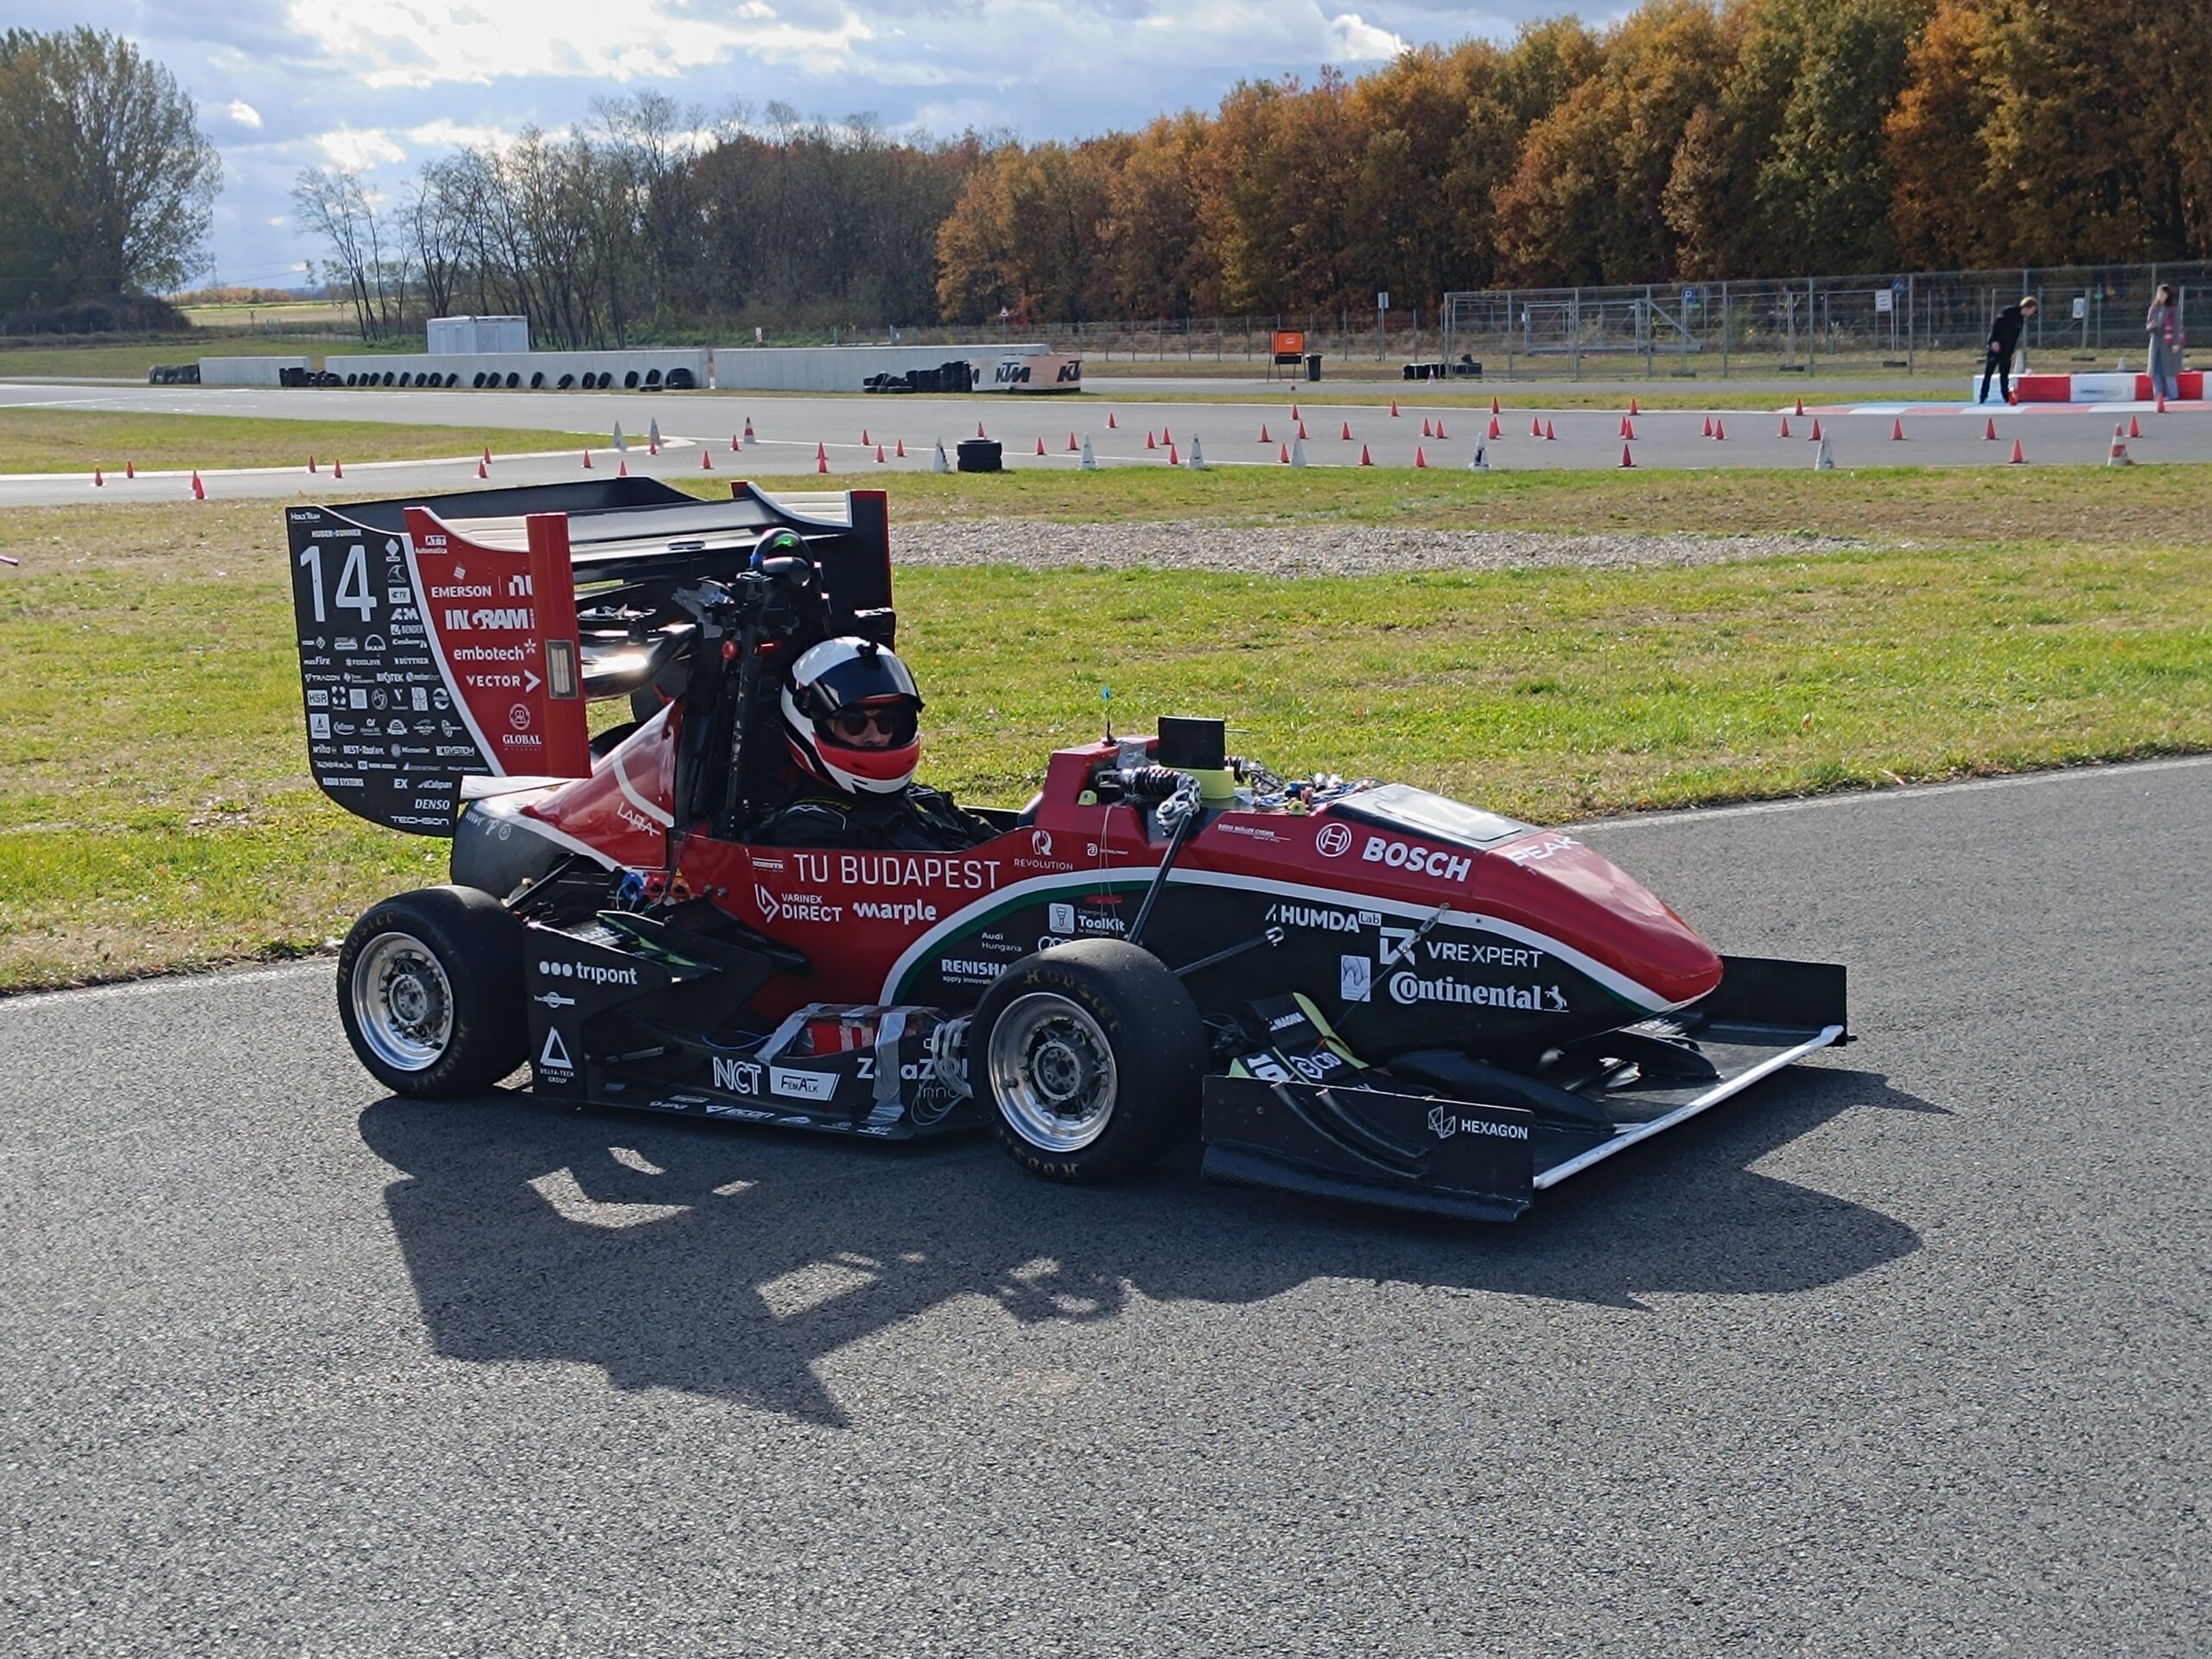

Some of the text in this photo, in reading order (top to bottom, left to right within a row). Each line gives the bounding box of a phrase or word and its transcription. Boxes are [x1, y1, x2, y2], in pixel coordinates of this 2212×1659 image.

[995, 362, 1031, 383] KTM
[1057, 360, 1081, 382] KT
[300, 545, 378, 622] 14
[431, 586, 492, 598] EMERSON
[454, 645, 524, 660] embotech
[467, 675, 521, 687] VECTOR
[309, 693, 327, 703] HSR
[502, 734, 543, 745] GLOBAL
[415, 799, 450, 810] DENSO
[617, 802, 661, 836] LARA
[1363, 836, 1471, 882] BOSCH
[1506, 836, 1581, 867] PEAK
[793, 854, 1001, 890] TU BUDAPEST
[1014, 859, 1074, 870] REVOLUTION
[781, 893, 823, 904] VARINEX
[782, 904, 843, 922] DIRECT
[1281, 904, 1380, 933] HUMDA Lab
[1077, 915, 1126, 931] ToolKit
[982, 942, 1022, 952] Hungaria
[1427, 941, 1544, 969] VREXPERT
[576, 962, 638, 985] tripont
[941, 959, 1007, 976] RENISHA
[1389, 971, 1544, 1010] Continental
[540, 1068, 575, 1077] DELTA-TECH
[713, 1057, 761, 1095] NCT
[1461, 1119, 1528, 1141] HEXAGON
